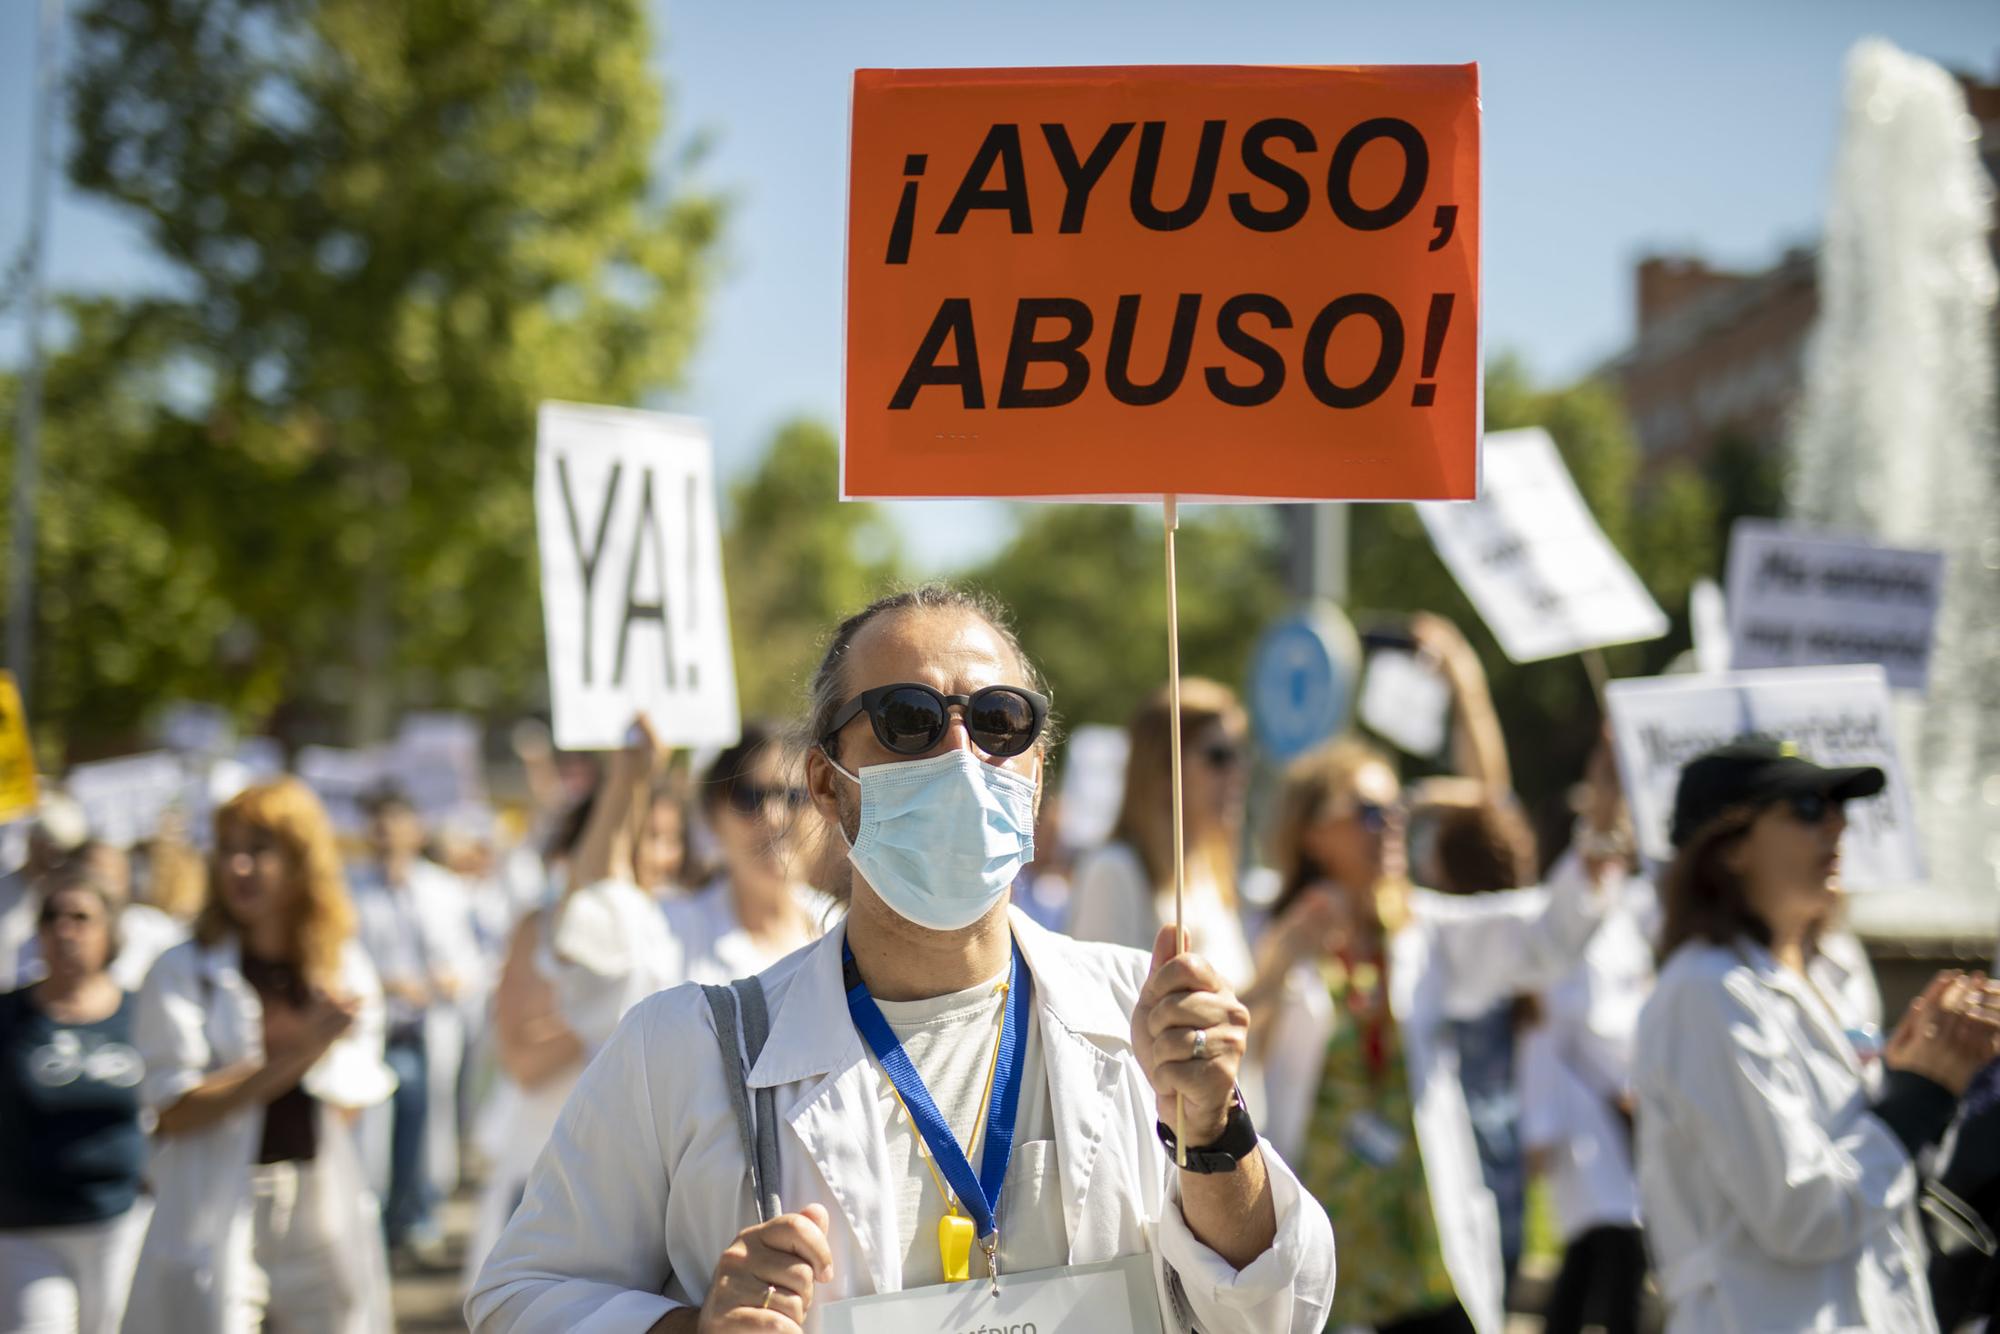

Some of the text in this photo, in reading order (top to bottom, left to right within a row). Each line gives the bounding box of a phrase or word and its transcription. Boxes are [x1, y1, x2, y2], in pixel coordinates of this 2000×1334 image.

[885, 117, 1459, 265] ¡AYUSO,
[887, 293, 1455, 411] ABUSO!
[556, 455, 698, 688] YA!
[958, 1322, 1037, 1334] ÉICO
